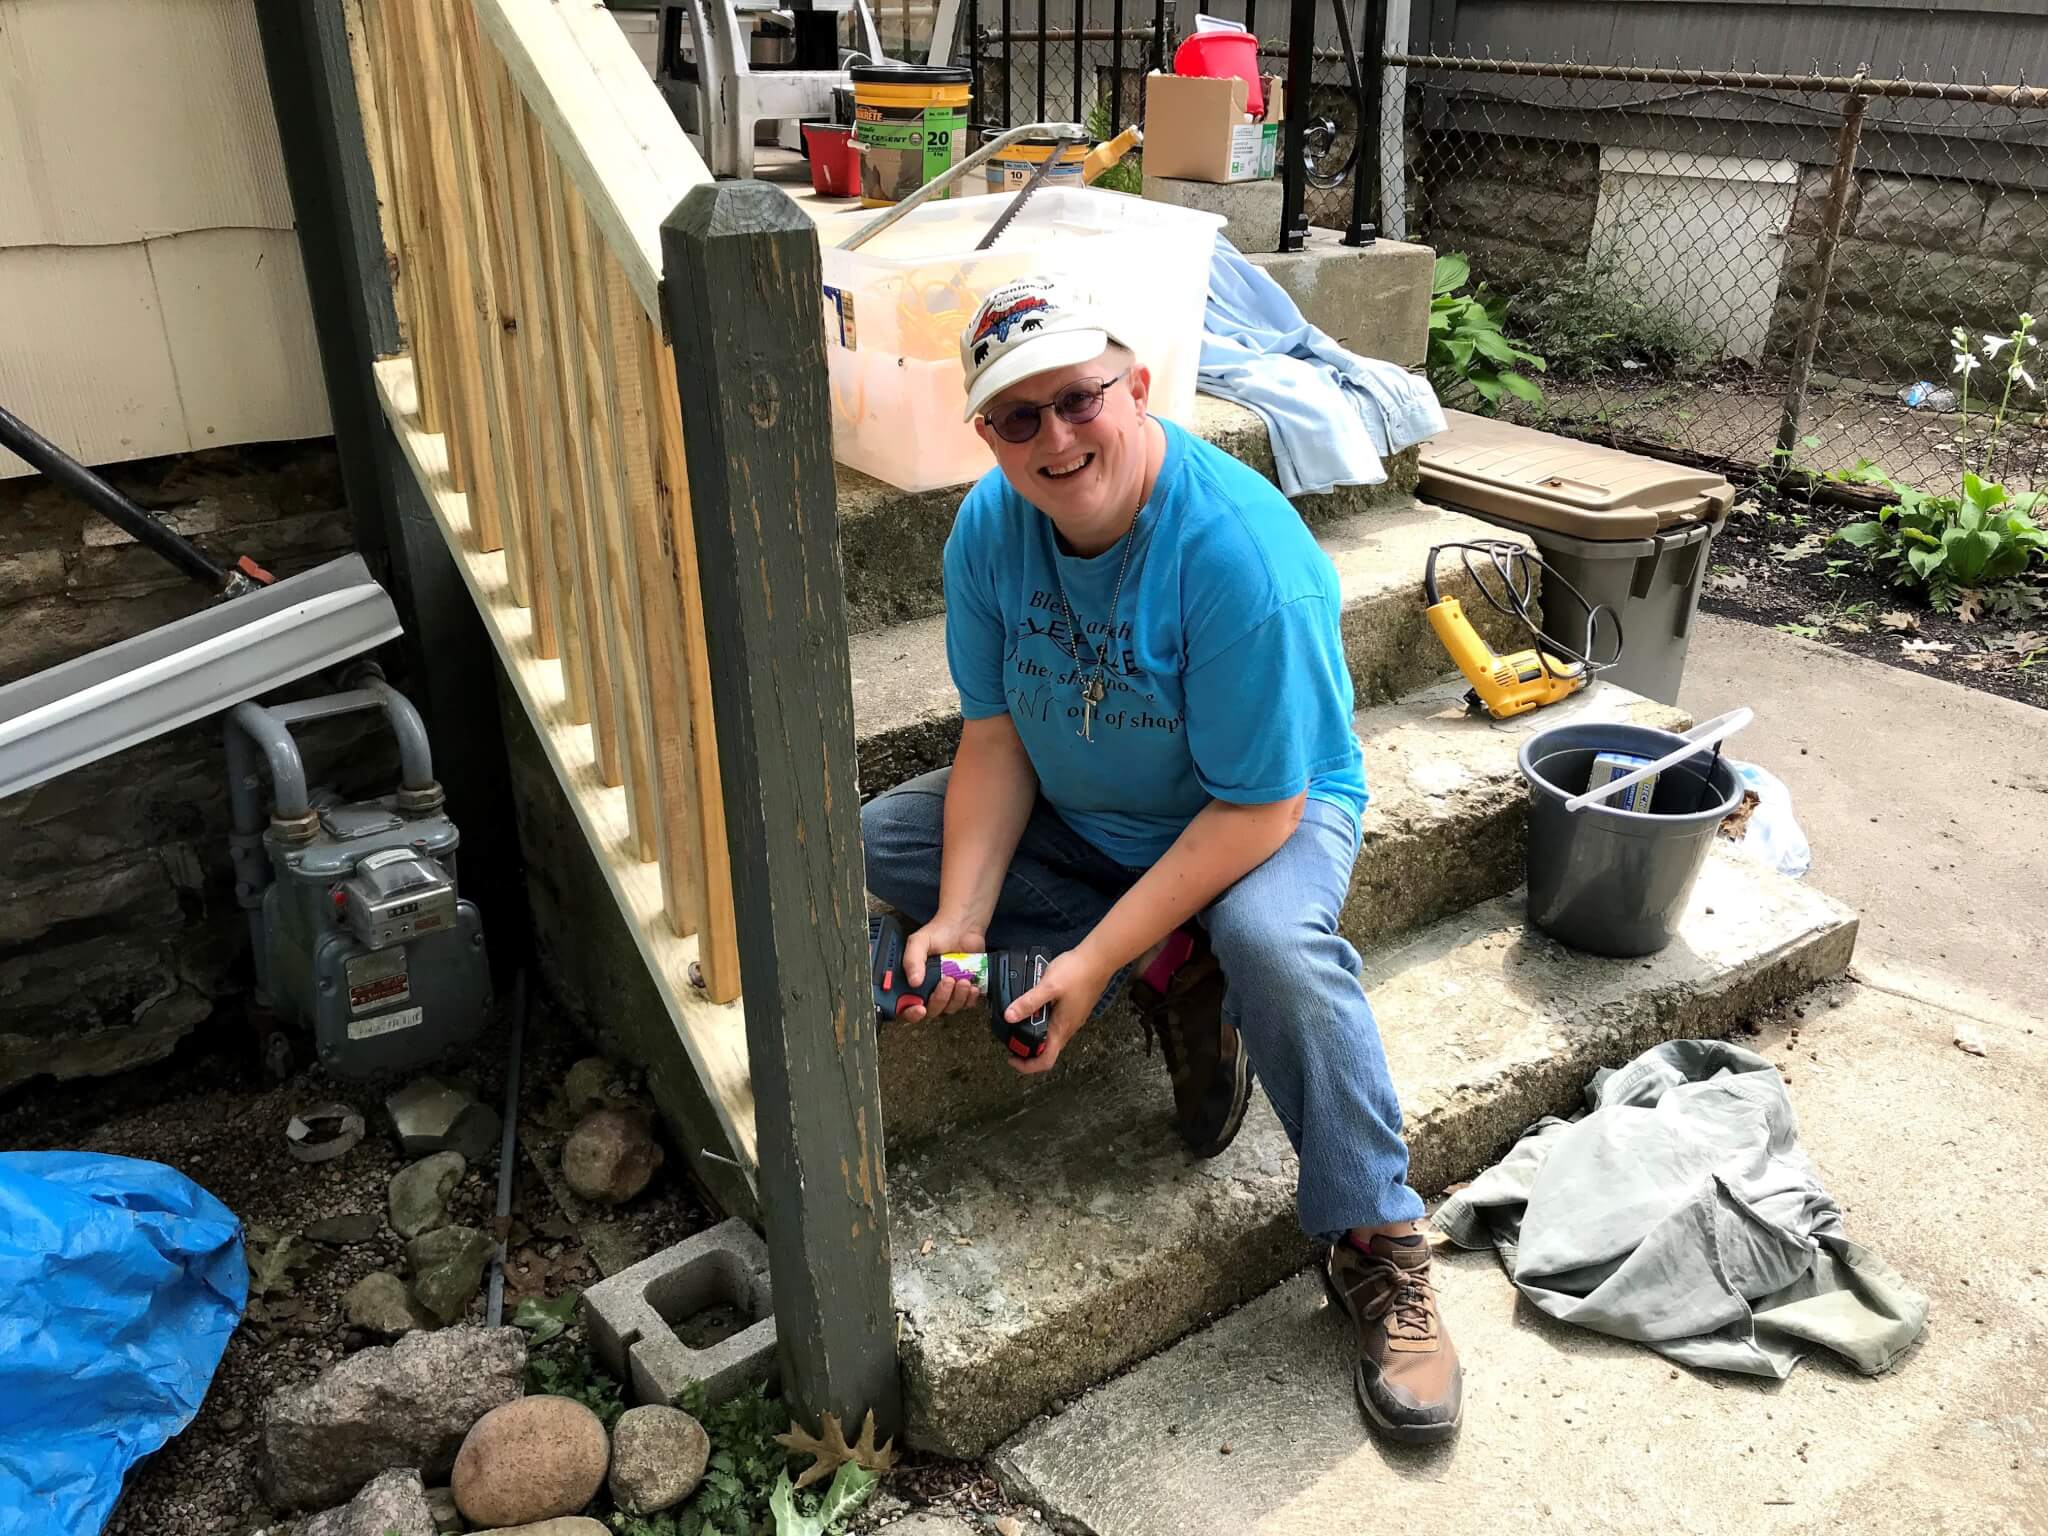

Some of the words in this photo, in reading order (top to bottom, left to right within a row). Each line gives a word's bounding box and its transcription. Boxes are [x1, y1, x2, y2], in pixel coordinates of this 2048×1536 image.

[928, 131, 949, 146] 20
[1011, 171, 1023, 180] 10
[1105, 710, 1127, 729] of
